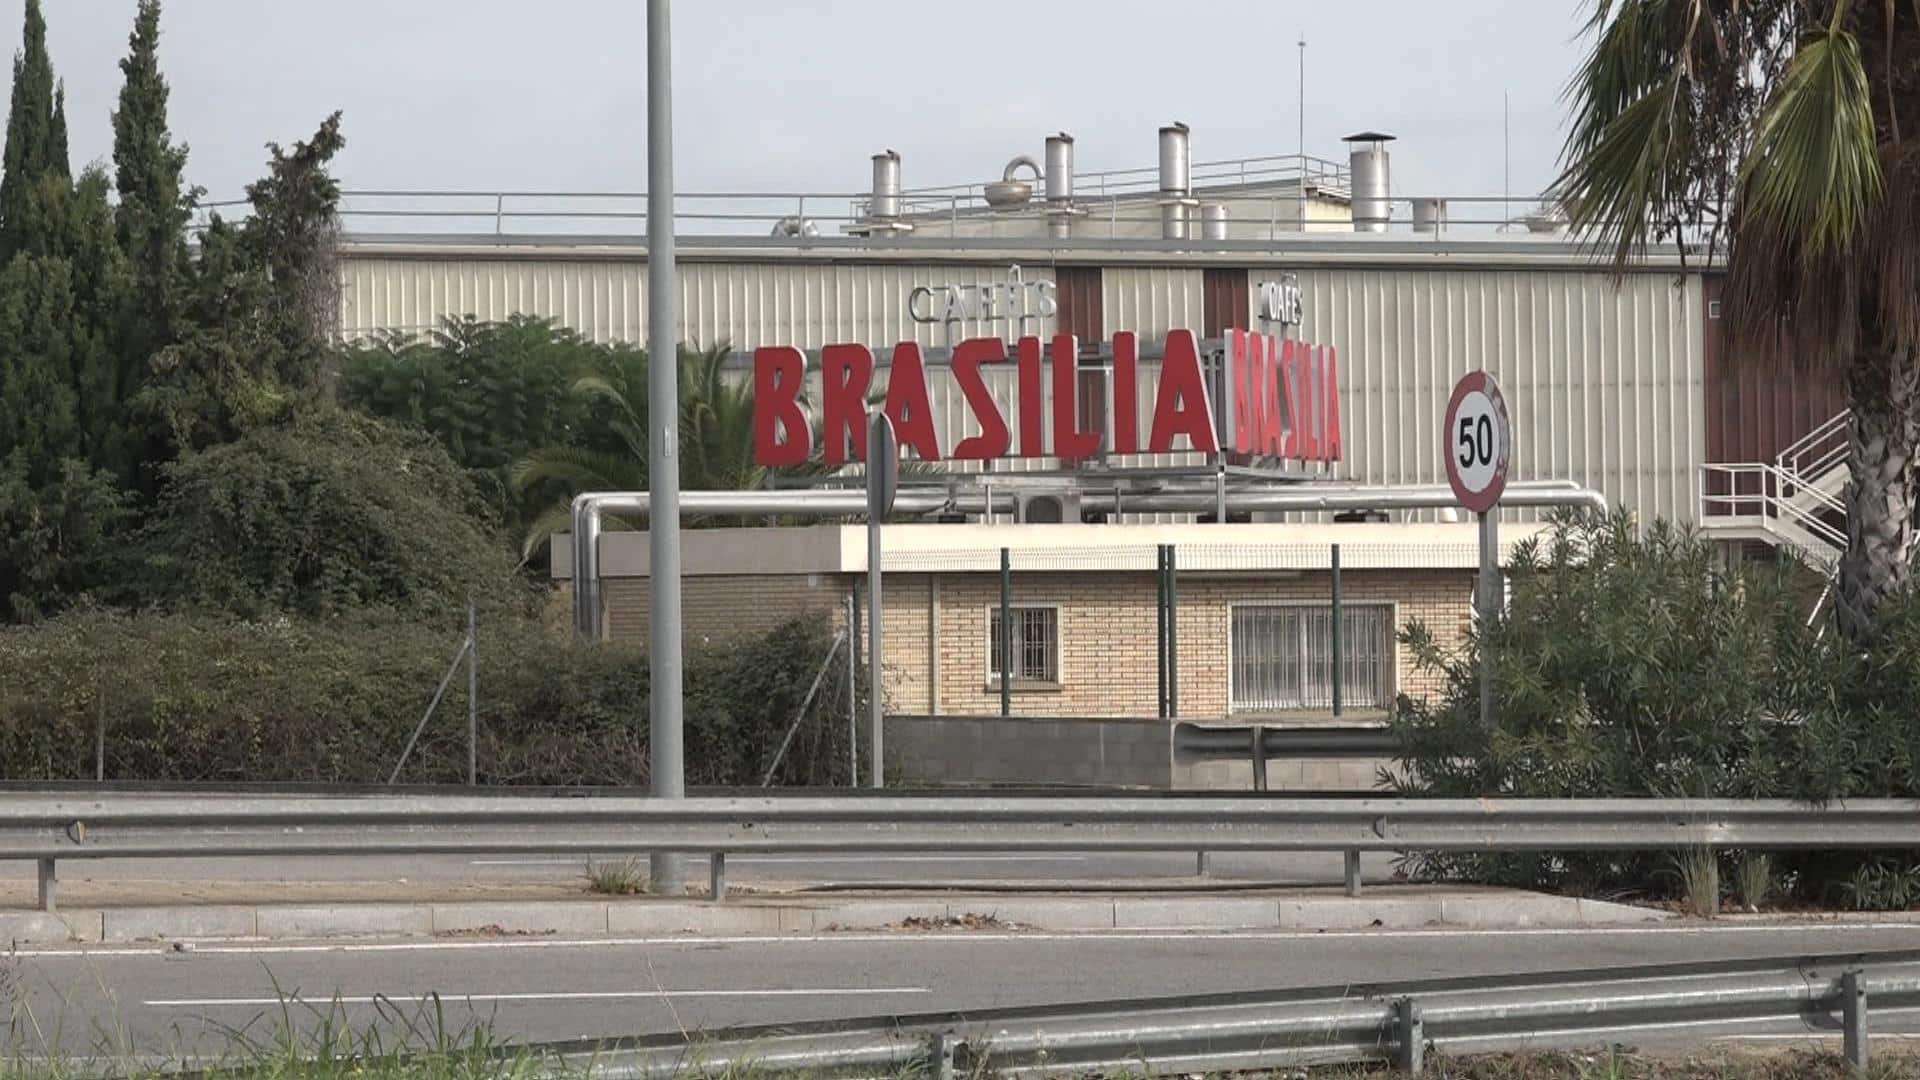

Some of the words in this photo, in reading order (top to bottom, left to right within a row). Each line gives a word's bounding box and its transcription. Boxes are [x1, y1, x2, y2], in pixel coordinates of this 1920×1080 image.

[754, 329, 1217, 465] BRASILIA
[1231, 327, 1343, 463] BRASILIA
[1459, 413, 1493, 468] 50
